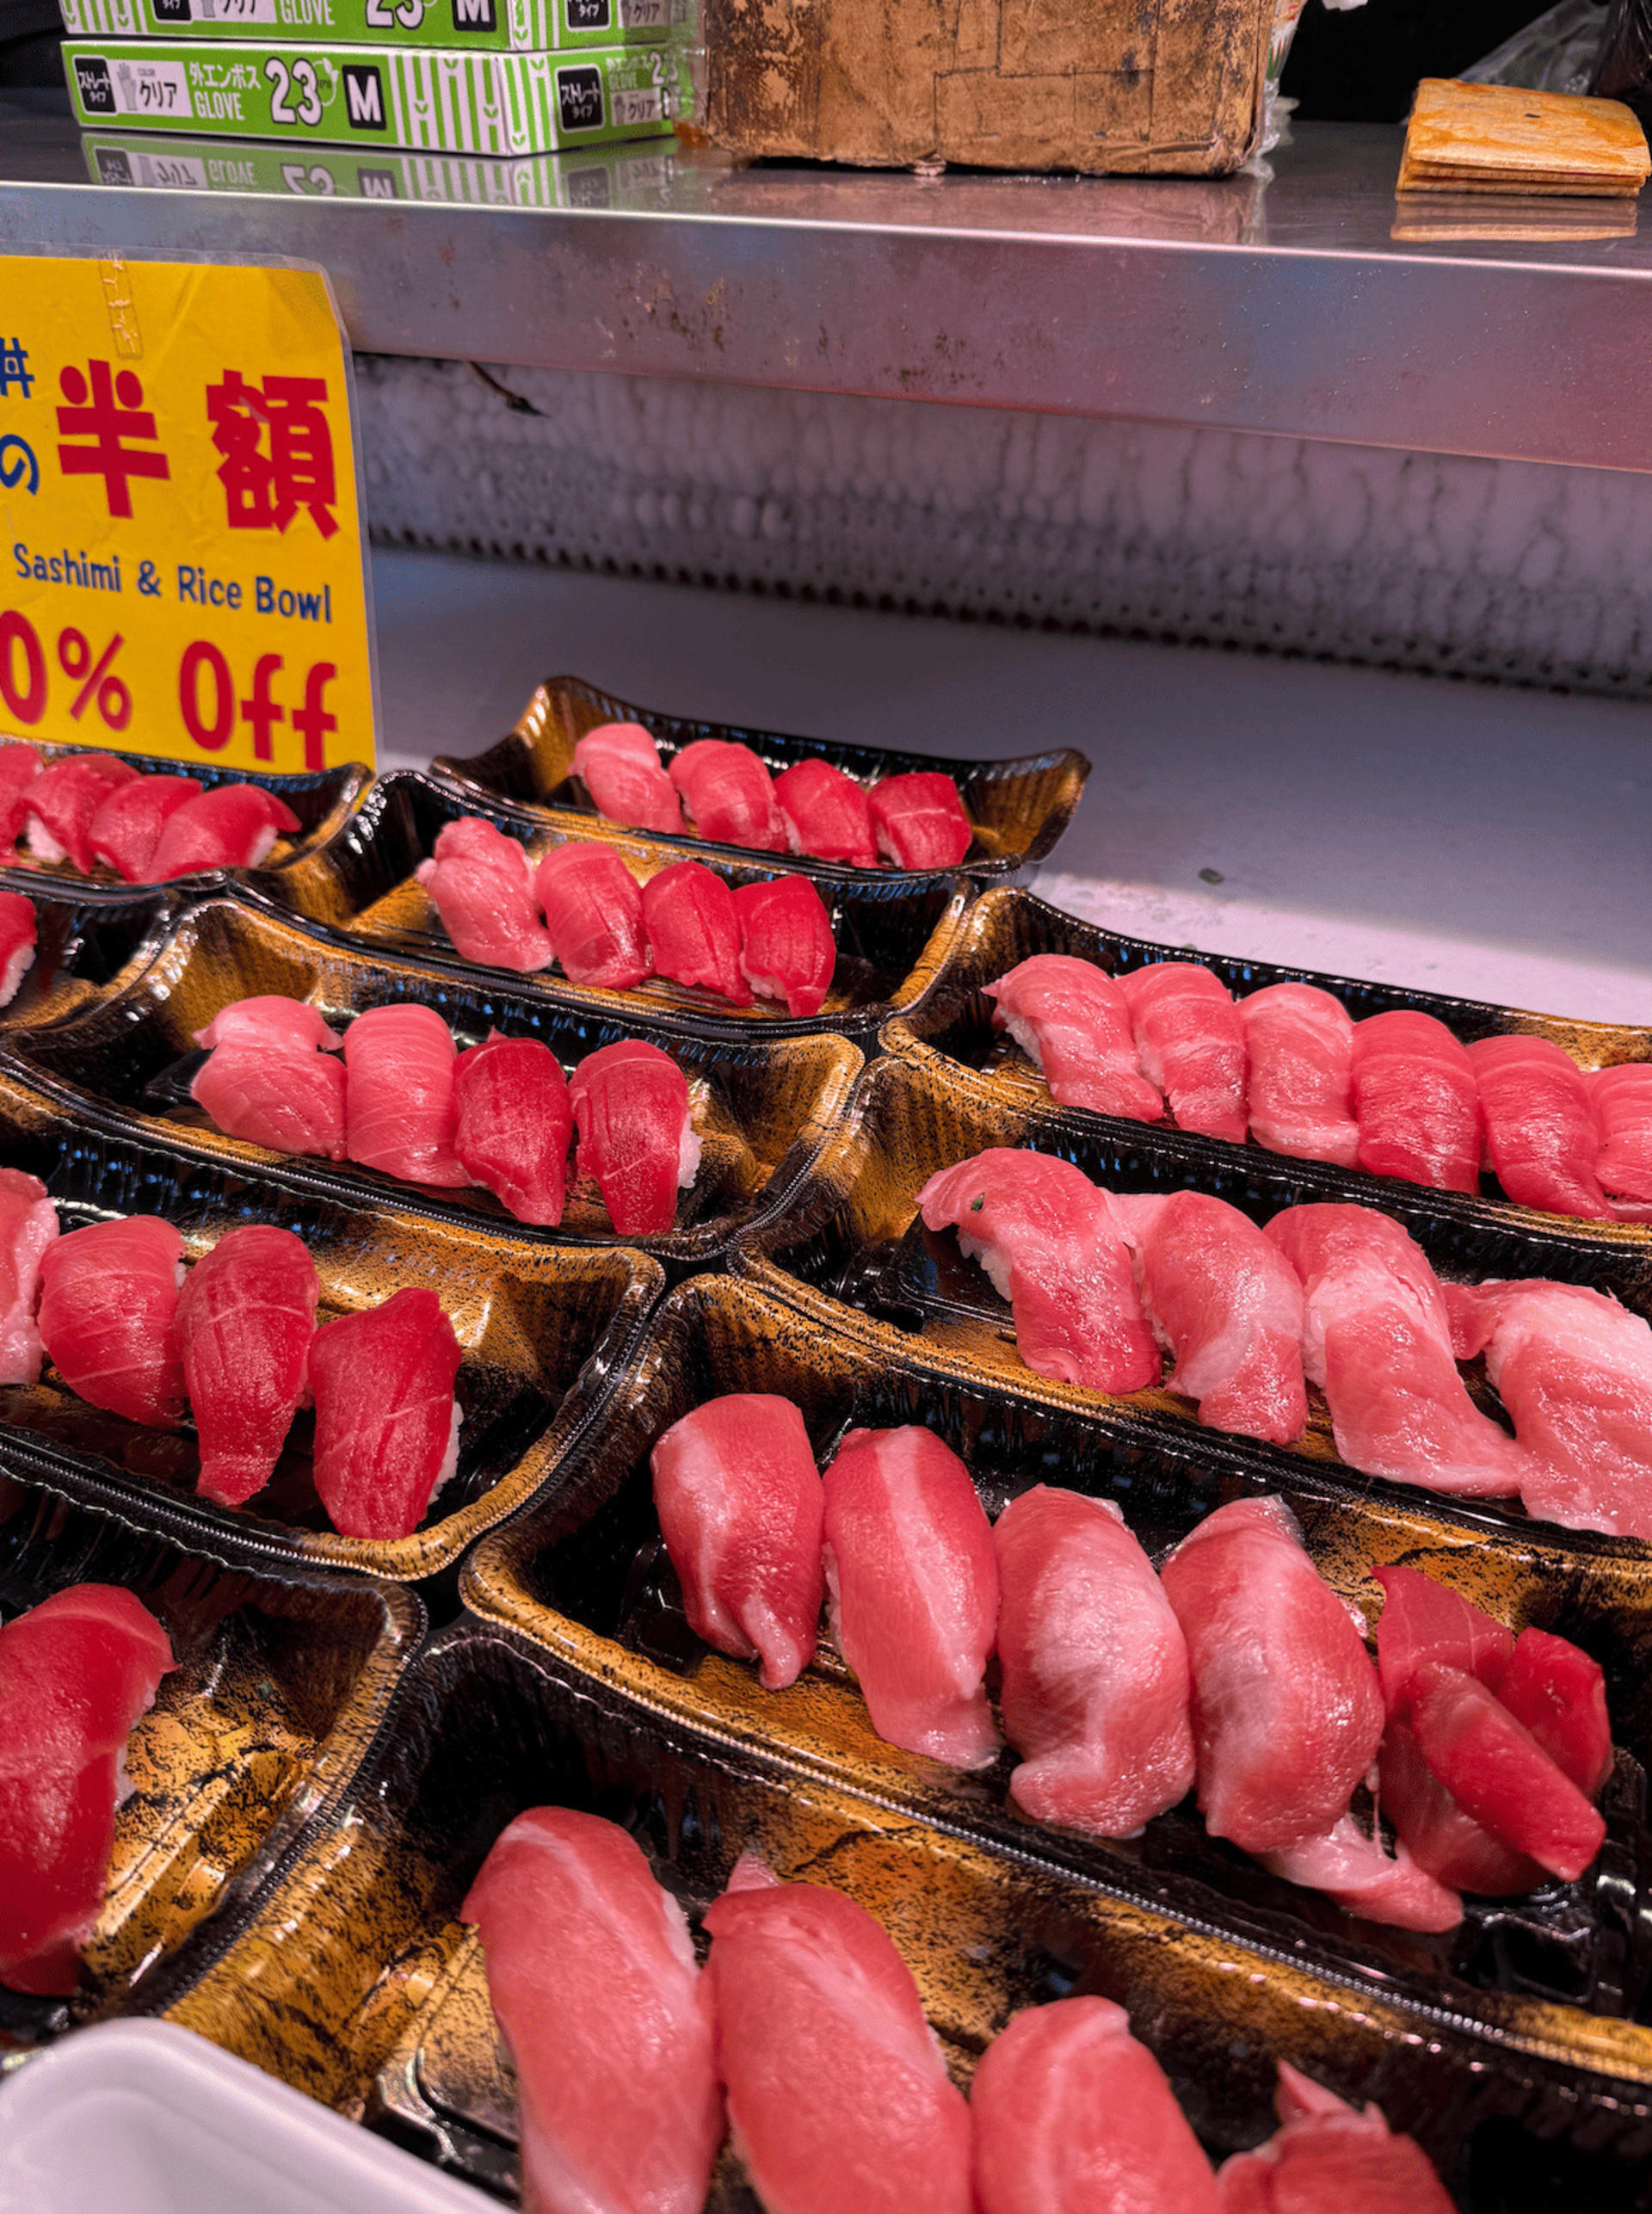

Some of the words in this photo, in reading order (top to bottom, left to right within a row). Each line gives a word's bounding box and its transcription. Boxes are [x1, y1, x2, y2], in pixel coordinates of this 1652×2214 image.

[77, 71, 112, 92] ストレート
[140, 80, 177, 108] クリア
[188, 61, 262, 89] 外エンボス
[263, 56, 324, 126] 23
[347, 74, 382, 122] M
[194, 91, 245, 120] GLOVE
[0, 434, 40, 496] の
[56, 359, 340, 540] 半額
[14, 542, 121, 592] Sashimi
[137, 560, 162, 597] &
[177, 565, 242, 609] Rice
[256, 576, 332, 624] Bowl
[0, 610, 132, 731] 0%
